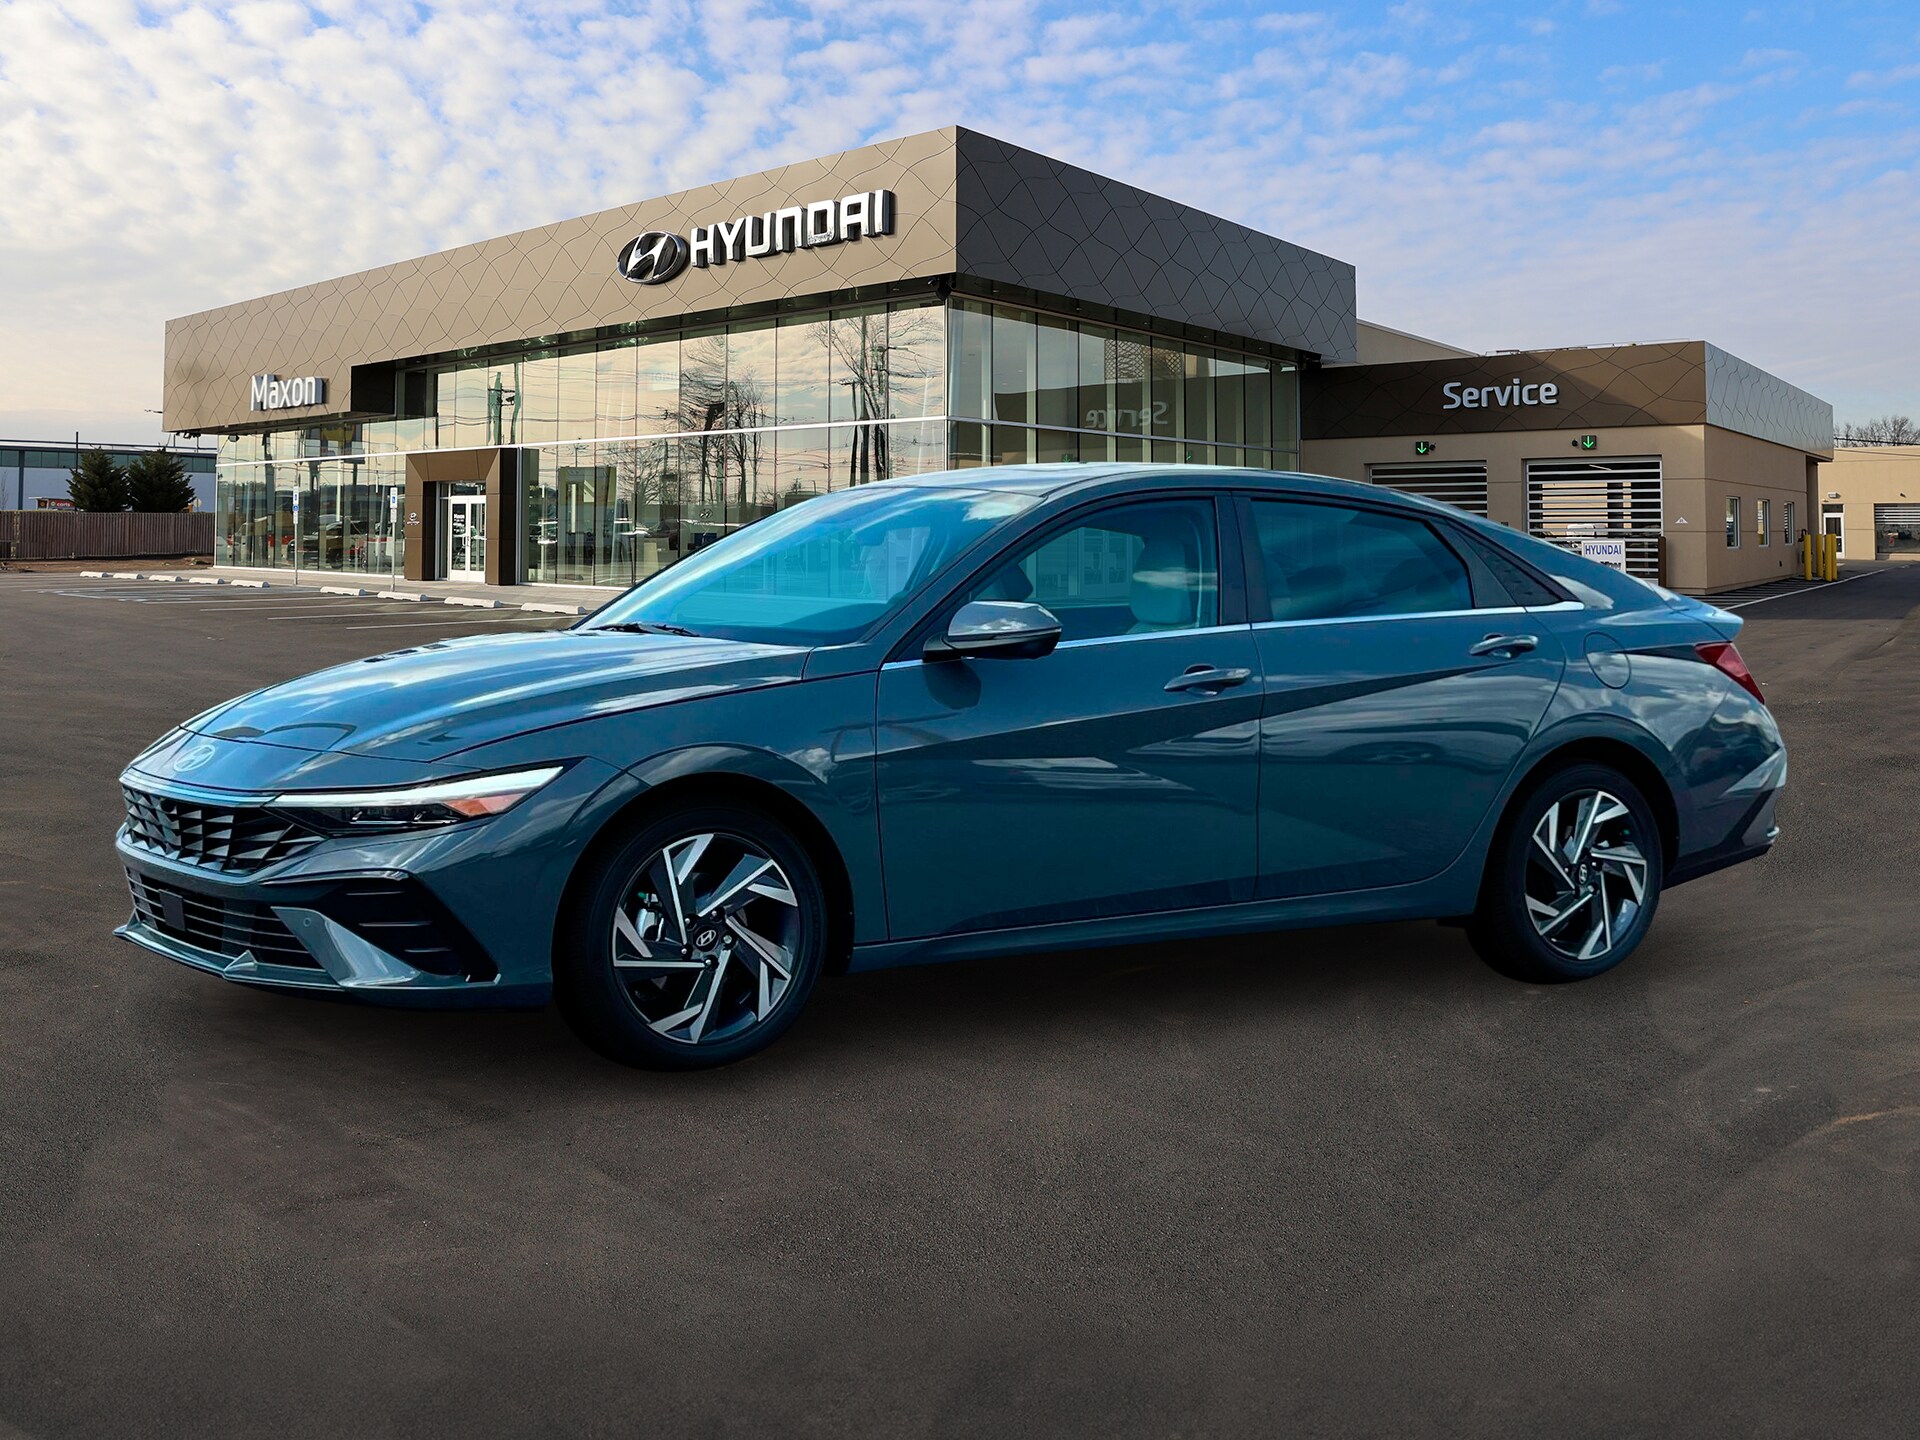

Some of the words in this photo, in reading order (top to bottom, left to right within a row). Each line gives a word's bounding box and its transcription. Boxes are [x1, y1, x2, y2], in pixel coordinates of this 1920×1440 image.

[690, 189, 892, 267] HYUNDAI
[250, 373, 319, 412] Maxon
[1442, 378, 1558, 409] Service
[1585, 544, 1622, 555] HYUNDAI
